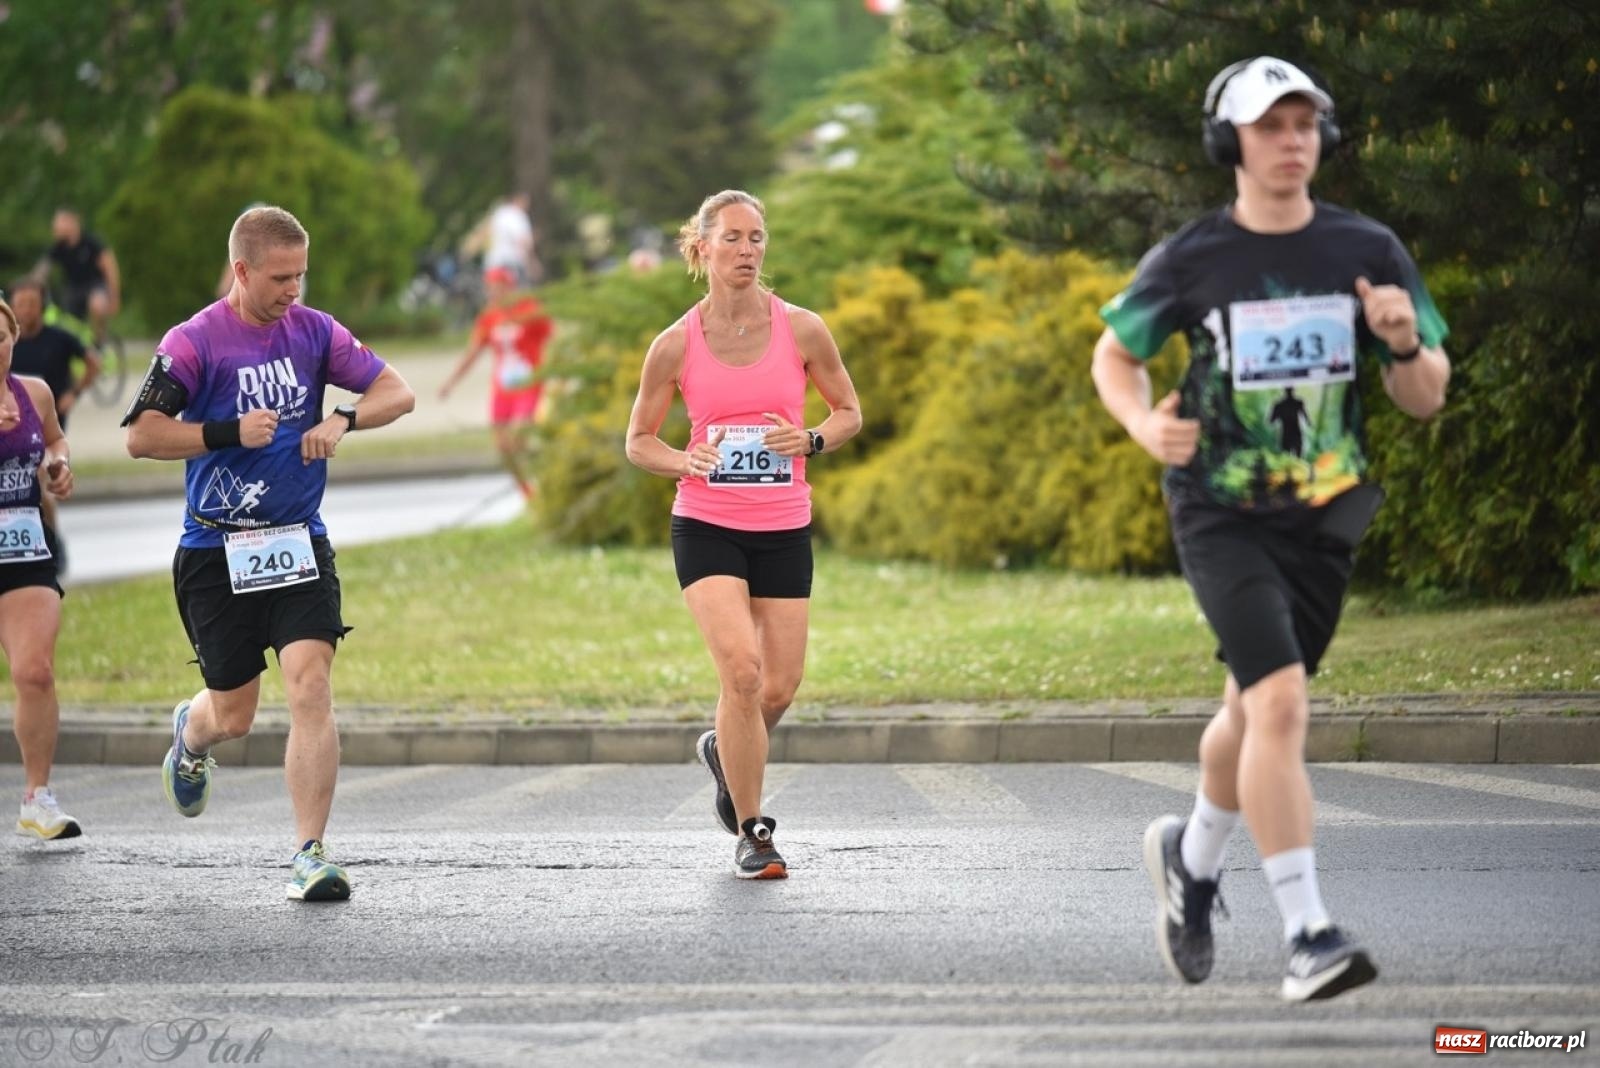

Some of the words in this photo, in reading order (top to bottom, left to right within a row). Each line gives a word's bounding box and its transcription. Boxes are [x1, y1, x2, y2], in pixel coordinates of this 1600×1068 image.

[1264, 332, 1325, 363] 243
[730, 450, 771, 470] 216
[0, 529, 31, 547] 236
[246, 530, 262, 539] BIEG
[263, 528, 276, 536] BEZ
[248, 550, 295, 575] 240
